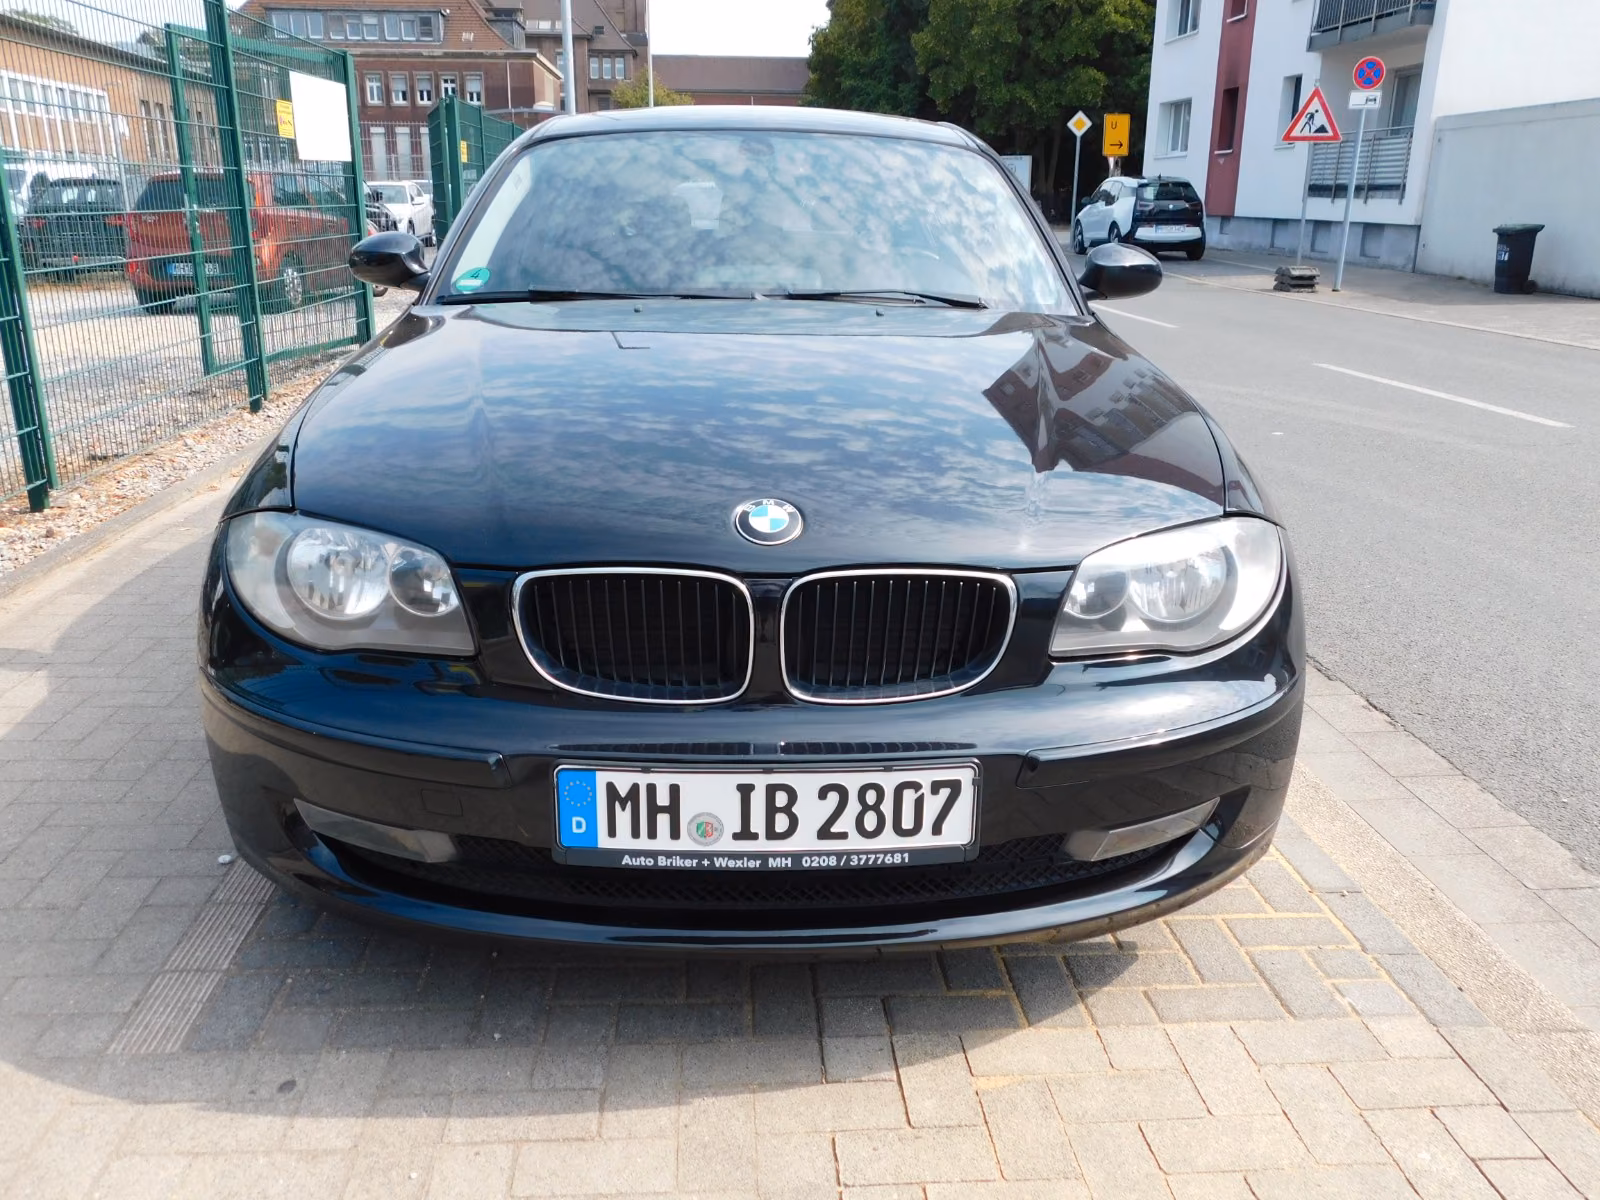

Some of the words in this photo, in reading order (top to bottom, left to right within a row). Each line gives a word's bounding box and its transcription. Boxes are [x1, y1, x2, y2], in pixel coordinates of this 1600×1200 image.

[1110, 120, 1118, 130] U
[470, 268, 482, 279] 4
[743, 499, 796, 512] BMW
[606, 781, 681, 840] MH
[732, 783, 798, 840] IB
[816, 779, 962, 840] 2807
[571, 816, 587, 834] D
[621, 854, 655, 866] Auto
[657, 855, 698, 867] Briker
[701, 859, 711, 868] +
[713, 856, 762, 869] Wexler
[768, 857, 792, 868] MH
[802, 855, 838, 867] 0208
[850, 853, 910, 866] 3777681
